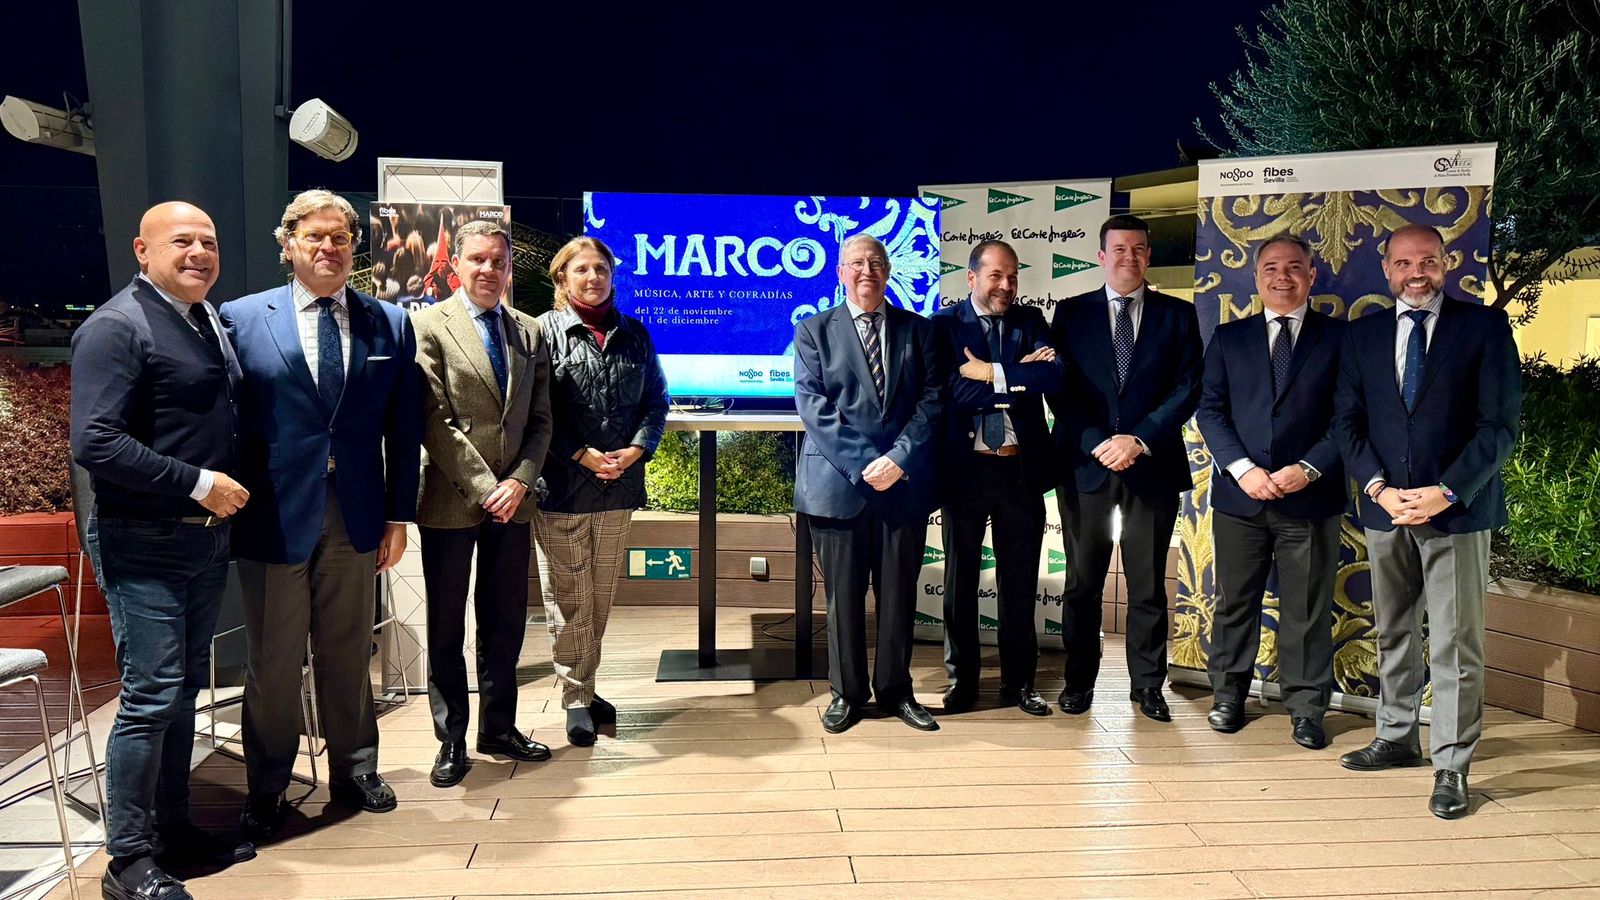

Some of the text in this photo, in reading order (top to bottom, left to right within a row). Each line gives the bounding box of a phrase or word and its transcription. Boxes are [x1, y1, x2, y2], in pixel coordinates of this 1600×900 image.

[1263, 167, 1294, 177] fibes
[943, 231, 967, 242] Corte
[1011, 225, 1086, 243] El Corte Inglés
[632, 233, 827, 279] MARCO
[634, 287, 793, 300] MÚSICA, ARTE Y COFRADÍAS
[1020, 295, 1045, 306] Corte
[634, 306, 733, 316] del 22 de noviembre
[656, 316, 668, 324] de
[671, 316, 719, 325] diciembre
[769, 369, 791, 377] fibes
